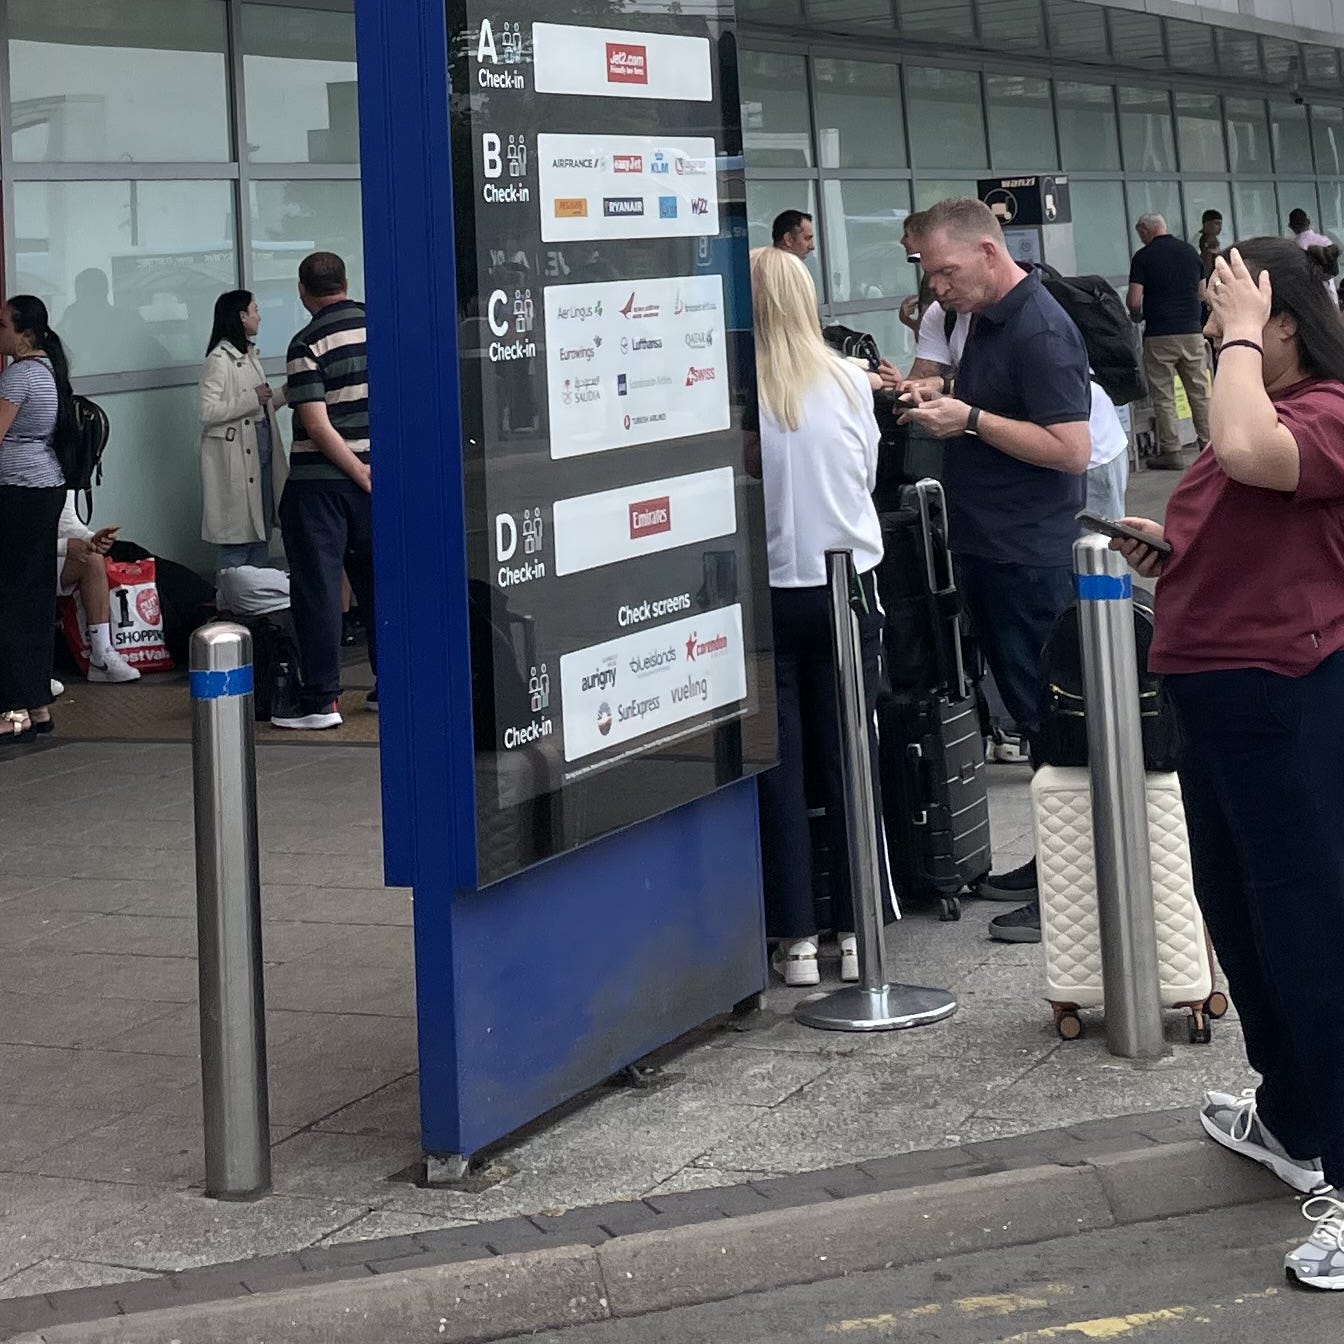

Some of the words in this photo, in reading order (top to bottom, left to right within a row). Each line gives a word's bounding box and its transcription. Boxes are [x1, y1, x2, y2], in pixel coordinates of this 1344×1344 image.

[477, 18, 498, 64] A
[610, 51, 644, 67] Jet2.com
[478, 68, 524, 89] Check-in
[482, 132, 503, 179] B
[614, 157, 642, 172] easyJet
[651, 163, 669, 174] KLM
[483, 183, 530, 203] Check-in
[608, 201, 643, 213] RYANAIR
[488, 289, 508, 337] C
[557, 308, 568, 319] Aer
[570, 306, 593, 321] Lingus
[489, 339, 535, 362] Check-in
[559, 346, 595, 361] Eurowings
[632, 339, 662, 351] Lufthansa
[695, 368, 715, 382] SWISS
[632, 507, 668, 529] Emirates
[496, 513, 517, 562] D
[498, 558, 545, 588] Check-in
[618, 601, 650, 627] Check
[652, 592, 691, 618] screens
[581, 665, 617, 692] aurigny
[697, 634, 727, 657] corendon
[617, 695, 660, 722] SunExpress
[670, 674, 708, 700] vueling
[504, 716, 553, 749] Check-in
